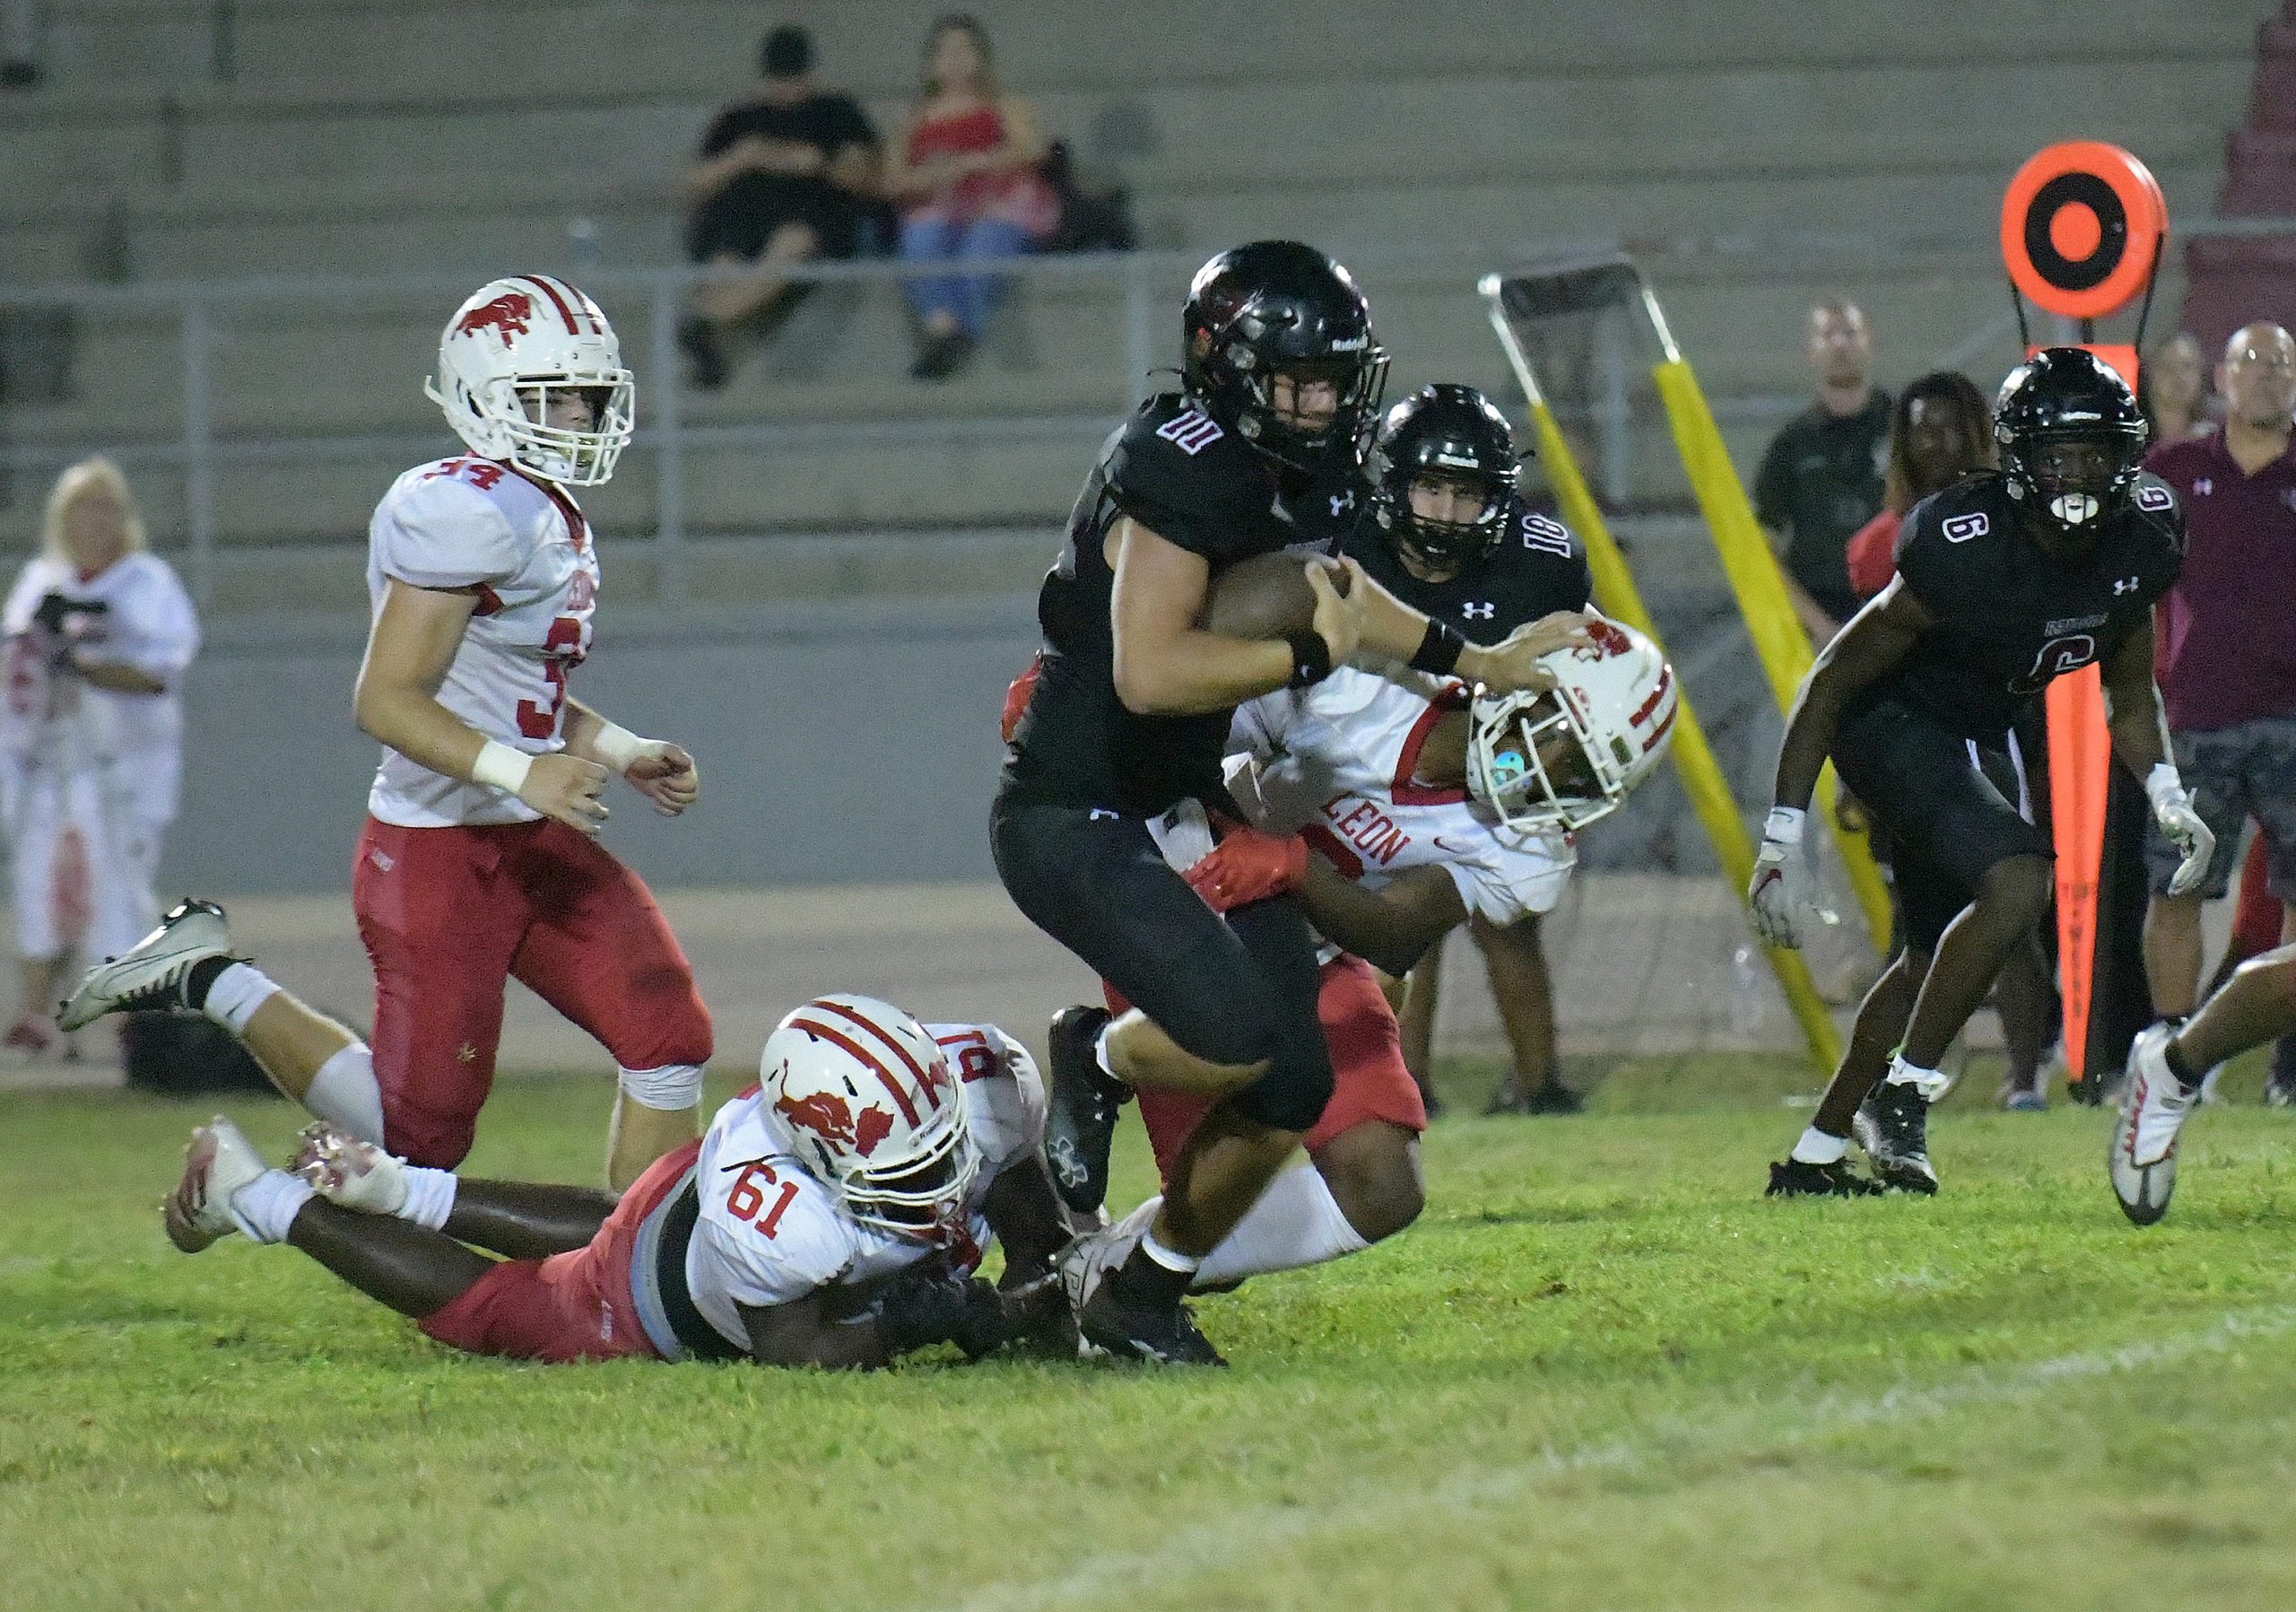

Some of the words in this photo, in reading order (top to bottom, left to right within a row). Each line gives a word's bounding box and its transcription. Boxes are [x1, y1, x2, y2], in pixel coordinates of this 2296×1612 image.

[1942, 512, 1990, 544] 6
[1323, 791, 1412, 866] LEON
[726, 1163, 800, 1242] 61
